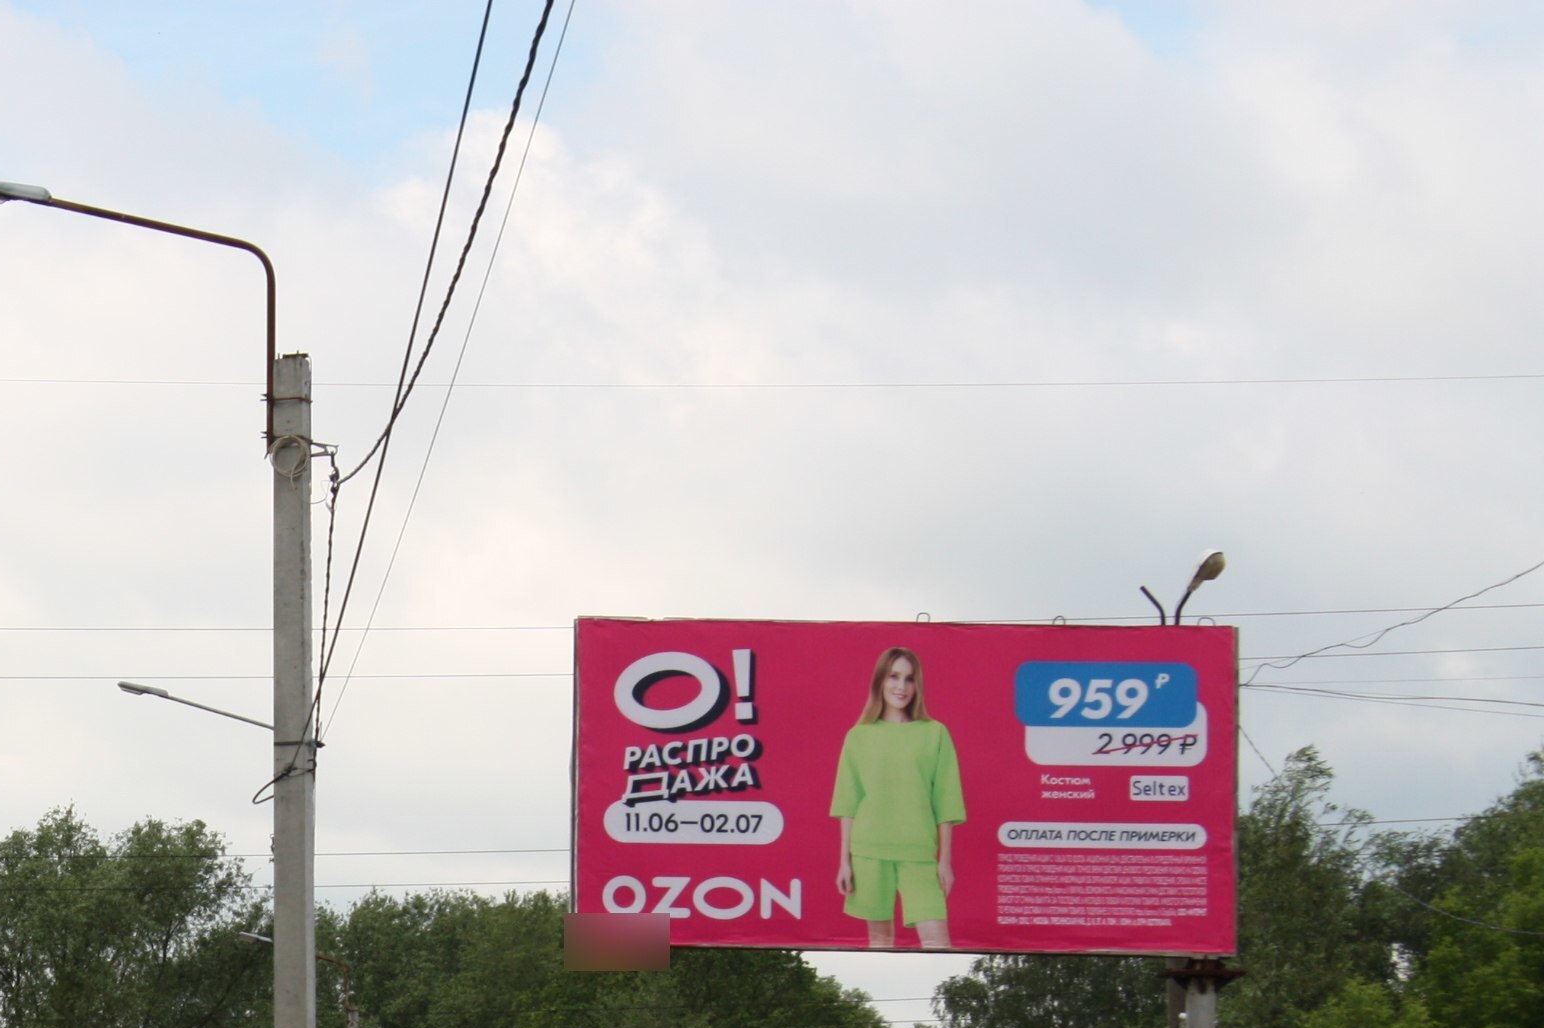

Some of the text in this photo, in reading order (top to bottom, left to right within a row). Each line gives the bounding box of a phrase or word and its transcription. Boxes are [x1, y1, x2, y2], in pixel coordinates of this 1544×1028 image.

[1048, 677, 1149, 720] 959
[622, 733, 759, 772] РАСПРО
[621, 762, 757, 805] ДАЖА
[1040, 774, 1091, 786] Костюм
[1040, 788, 1096, 800] женский
[1132, 780, 1186, 797] Seltex
[1007, 828, 1196, 843] ОПЛАТА ПОСЛЕ ПРИМЕРКИ
[601, 874, 802, 921] OZON
